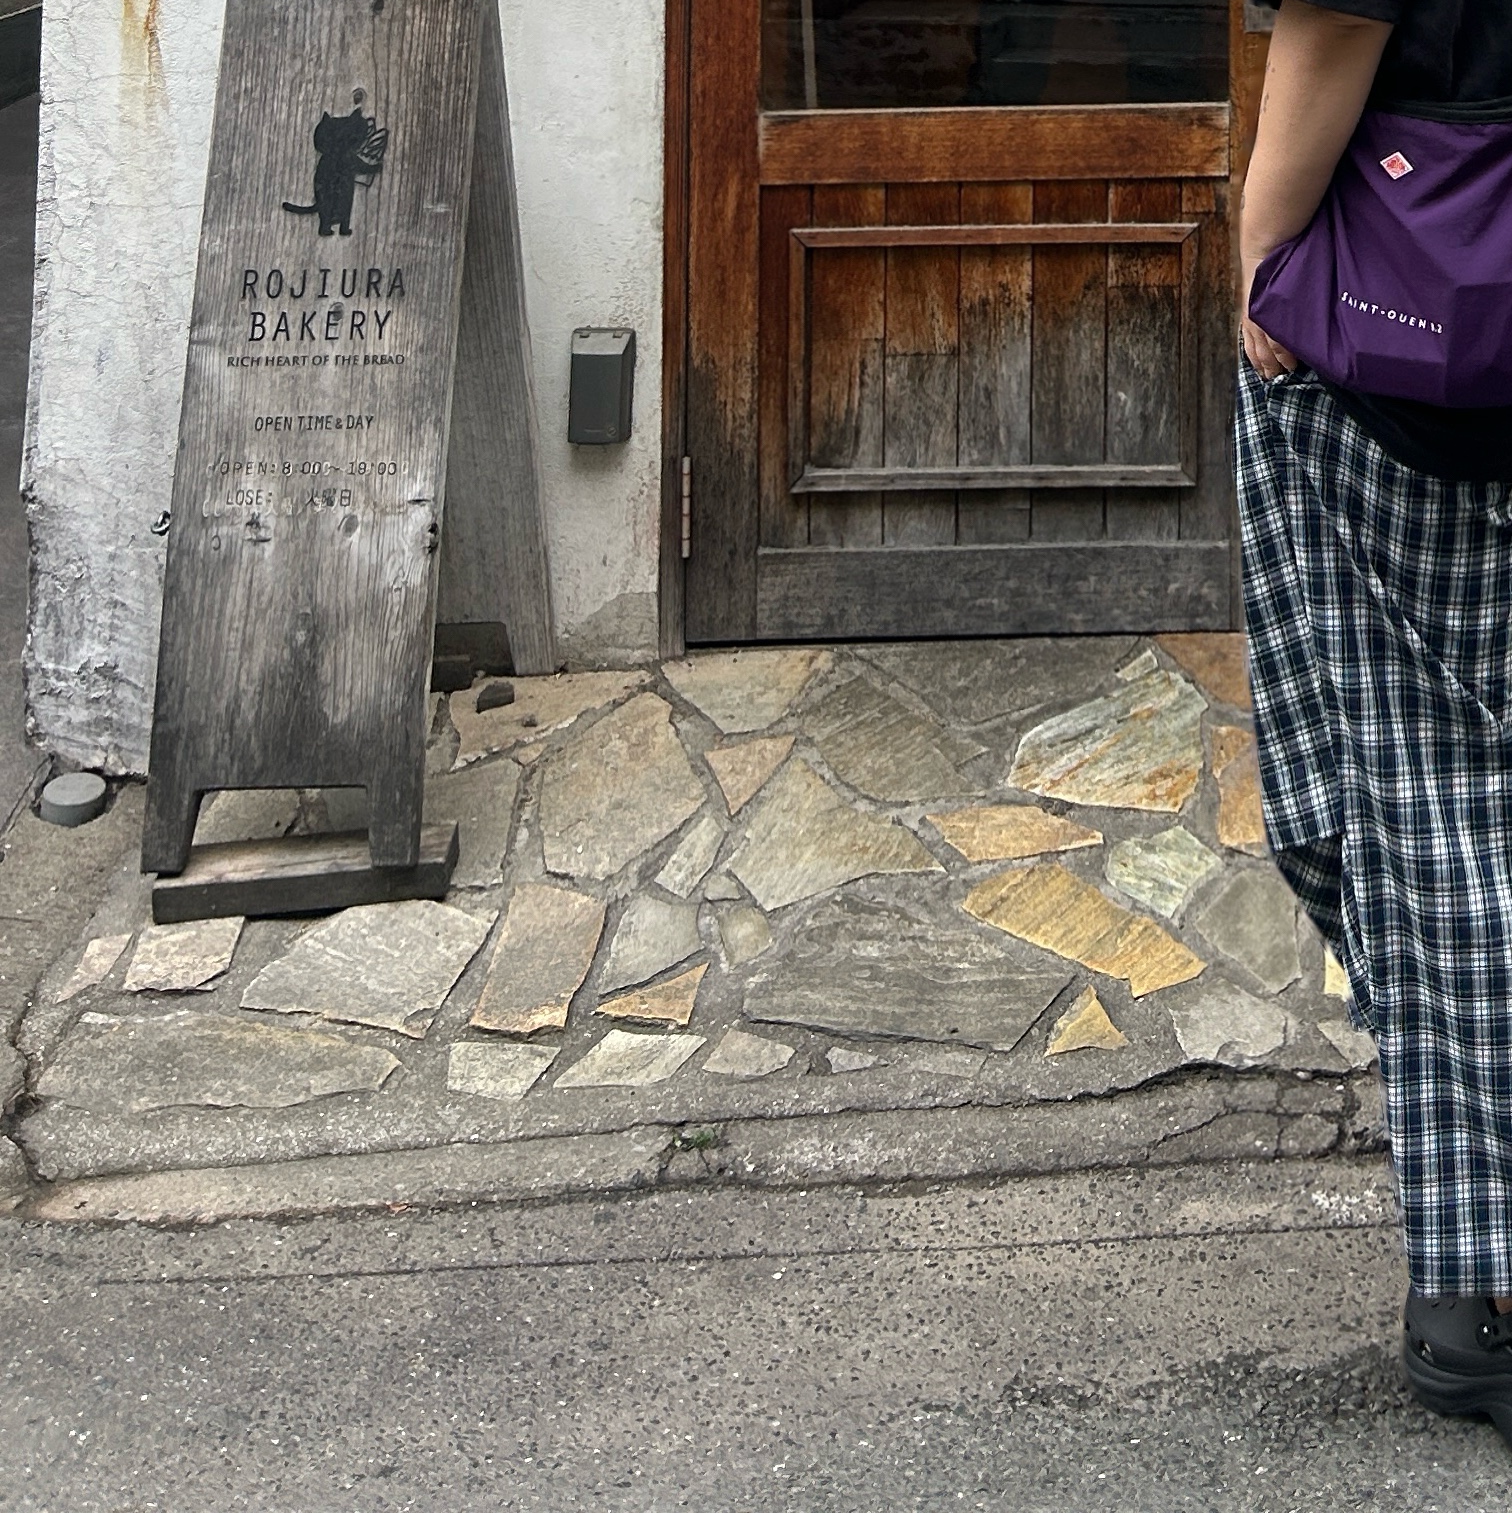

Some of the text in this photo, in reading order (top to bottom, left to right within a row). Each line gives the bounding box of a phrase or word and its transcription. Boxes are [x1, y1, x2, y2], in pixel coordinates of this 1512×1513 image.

[241, 268, 406, 300] ROJIURA
[248, 310, 392, 342] BAKERY
[227, 354, 405, 368] RICH HEART OF THE BREAD
[254, 416, 293, 432] OPEN
